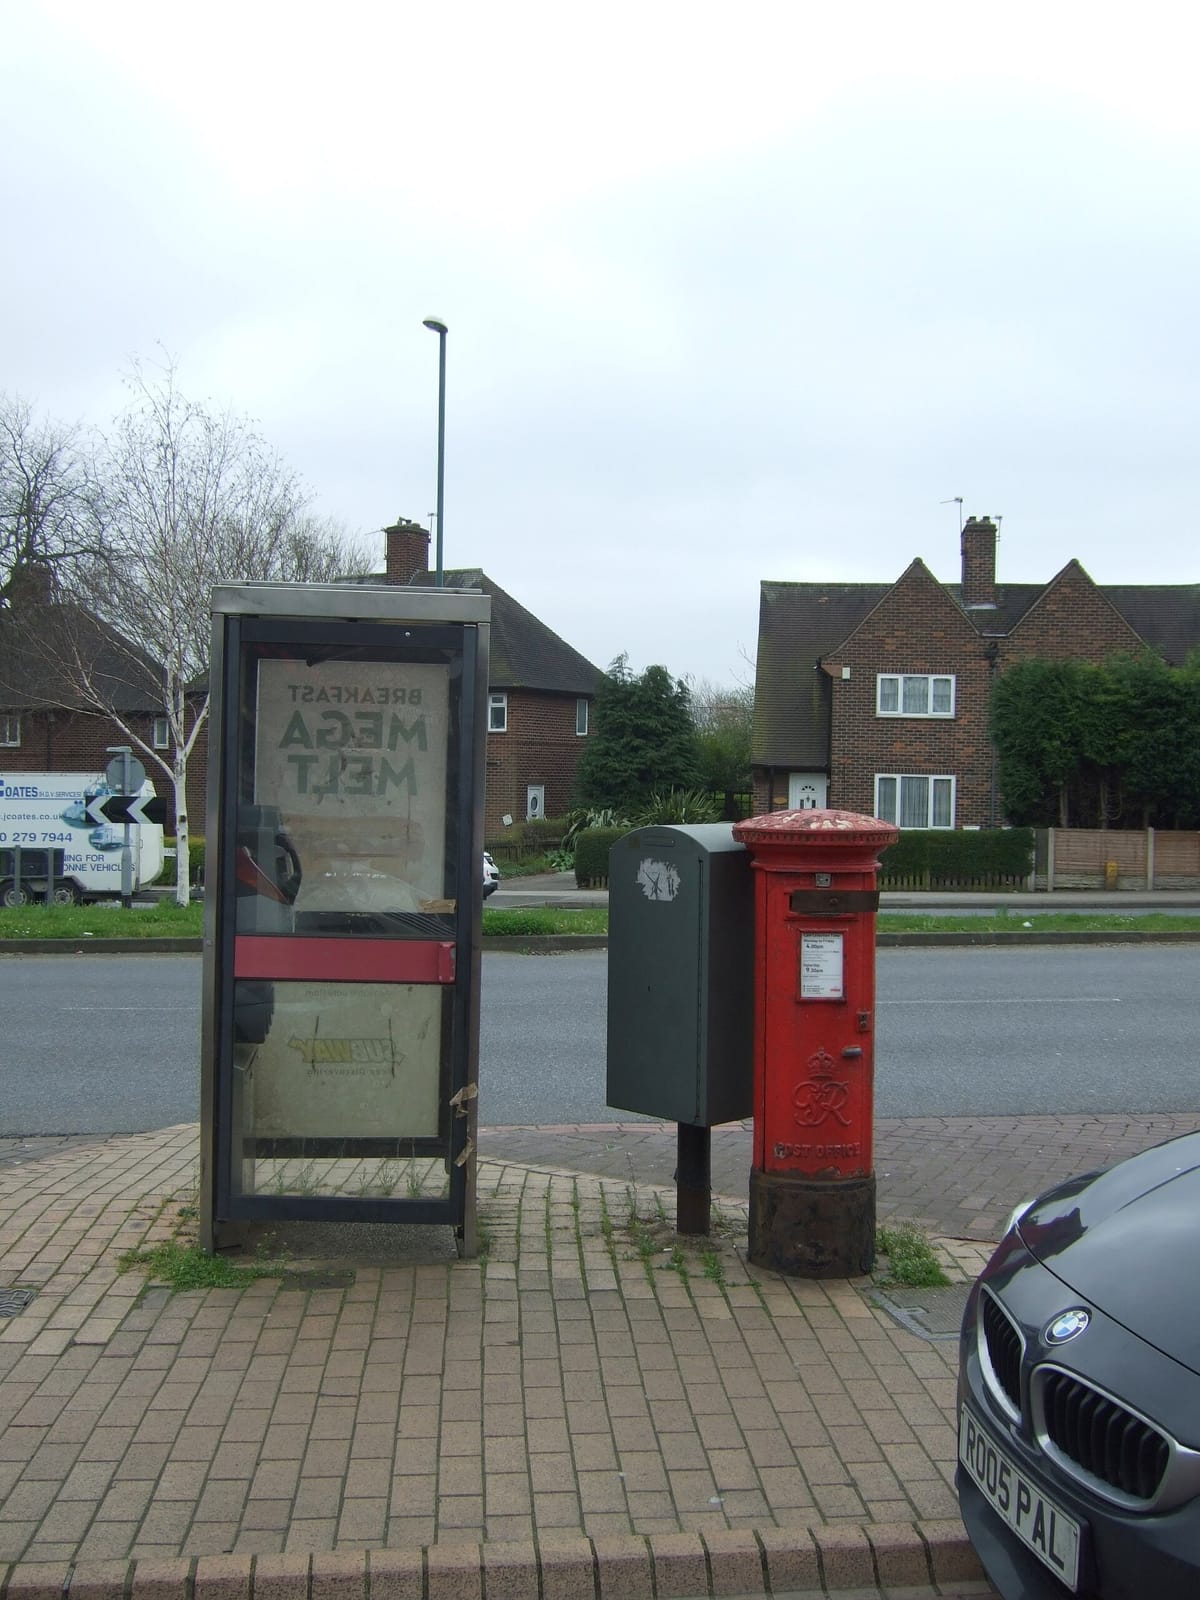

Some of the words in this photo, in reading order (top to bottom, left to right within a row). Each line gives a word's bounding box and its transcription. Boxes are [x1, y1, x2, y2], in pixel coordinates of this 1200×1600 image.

[12, 832, 37, 842] 279
[41, 832, 73, 842] 7944
[90, 863, 135, 872] VEHICLS
[774, 1142, 811, 1160] POST
[815, 1142, 862, 1160] OFFICE
[1015, 1479, 1065, 1572] PAL
